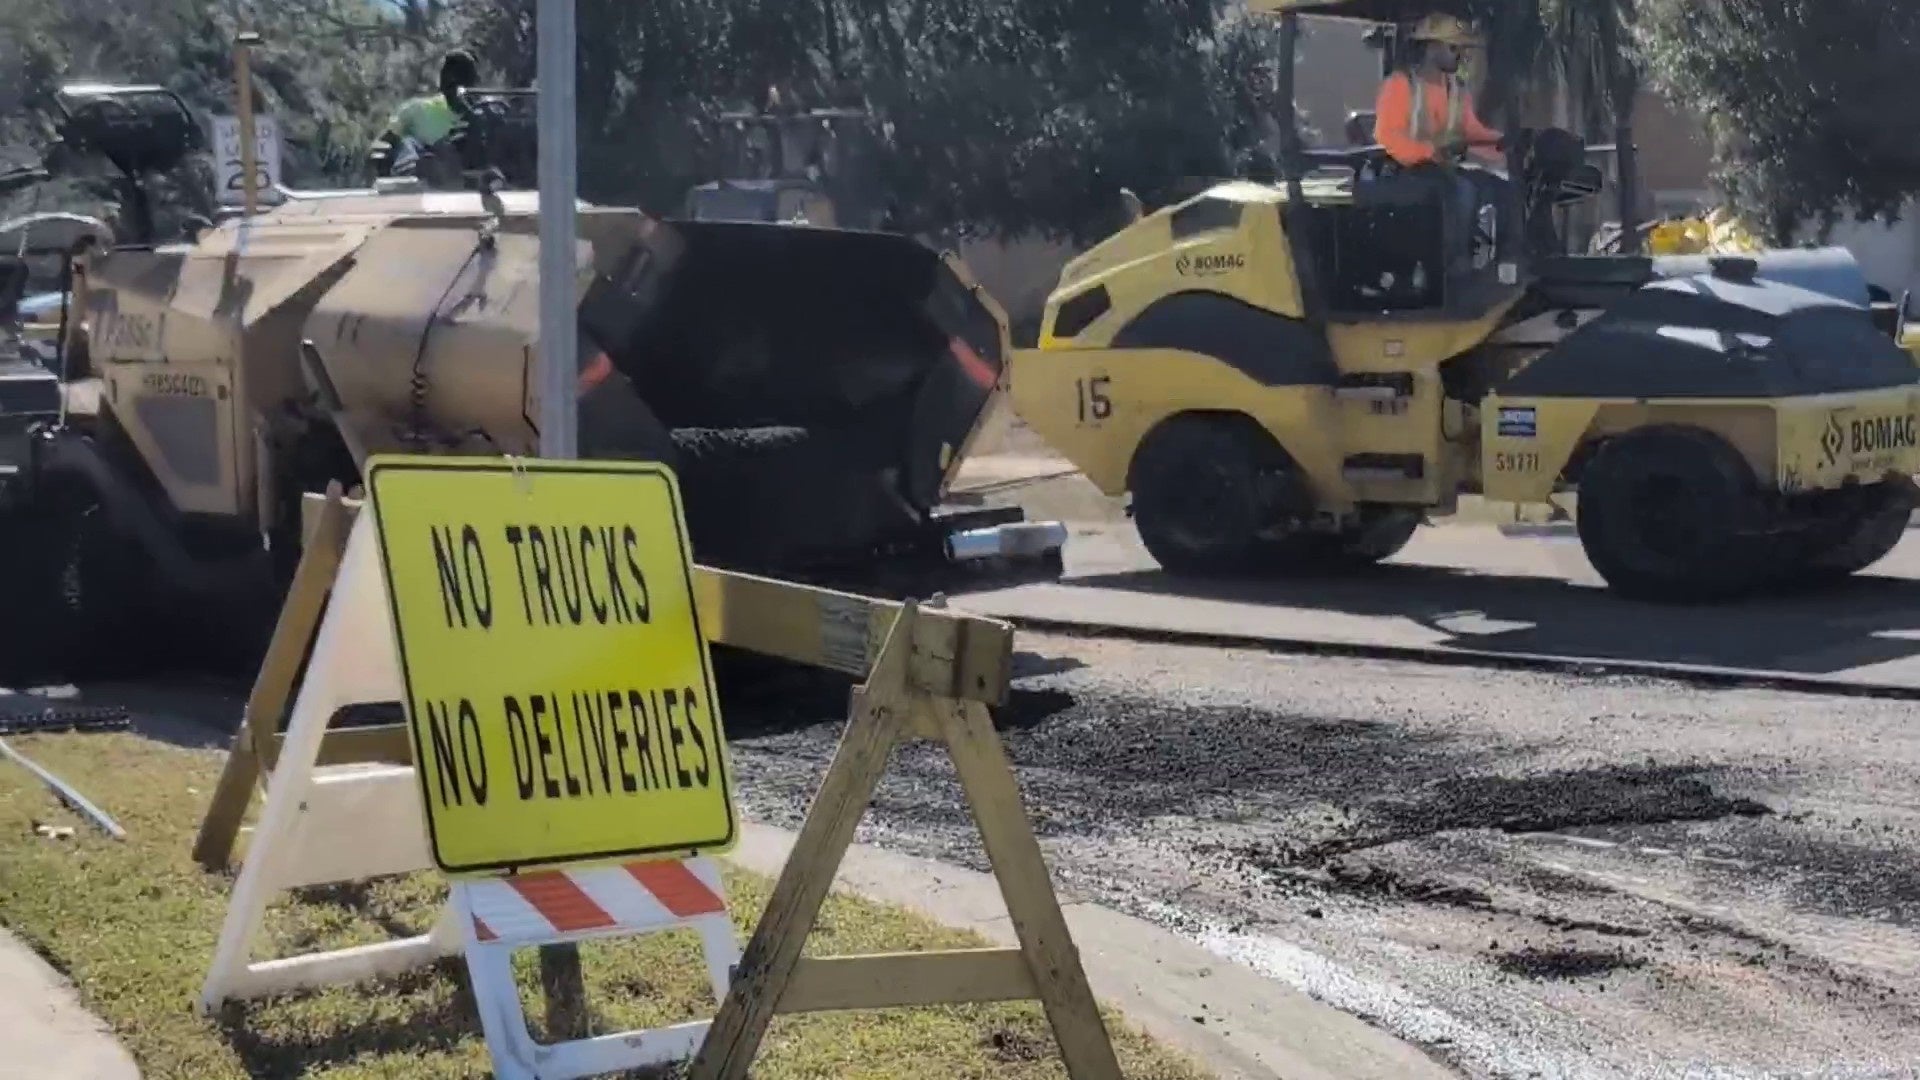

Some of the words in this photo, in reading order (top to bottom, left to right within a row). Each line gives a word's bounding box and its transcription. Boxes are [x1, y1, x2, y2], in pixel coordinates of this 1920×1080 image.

[1195, 254, 1244, 269] BOMAG
[1076, 376, 1111, 422] 15
[1851, 414, 1916, 453] BOMAG
[431, 523, 492, 629] NO
[505, 523, 652, 626] TRUCKS
[426, 697, 489, 811] NO
[502, 686, 710, 801] DELIVERIES
